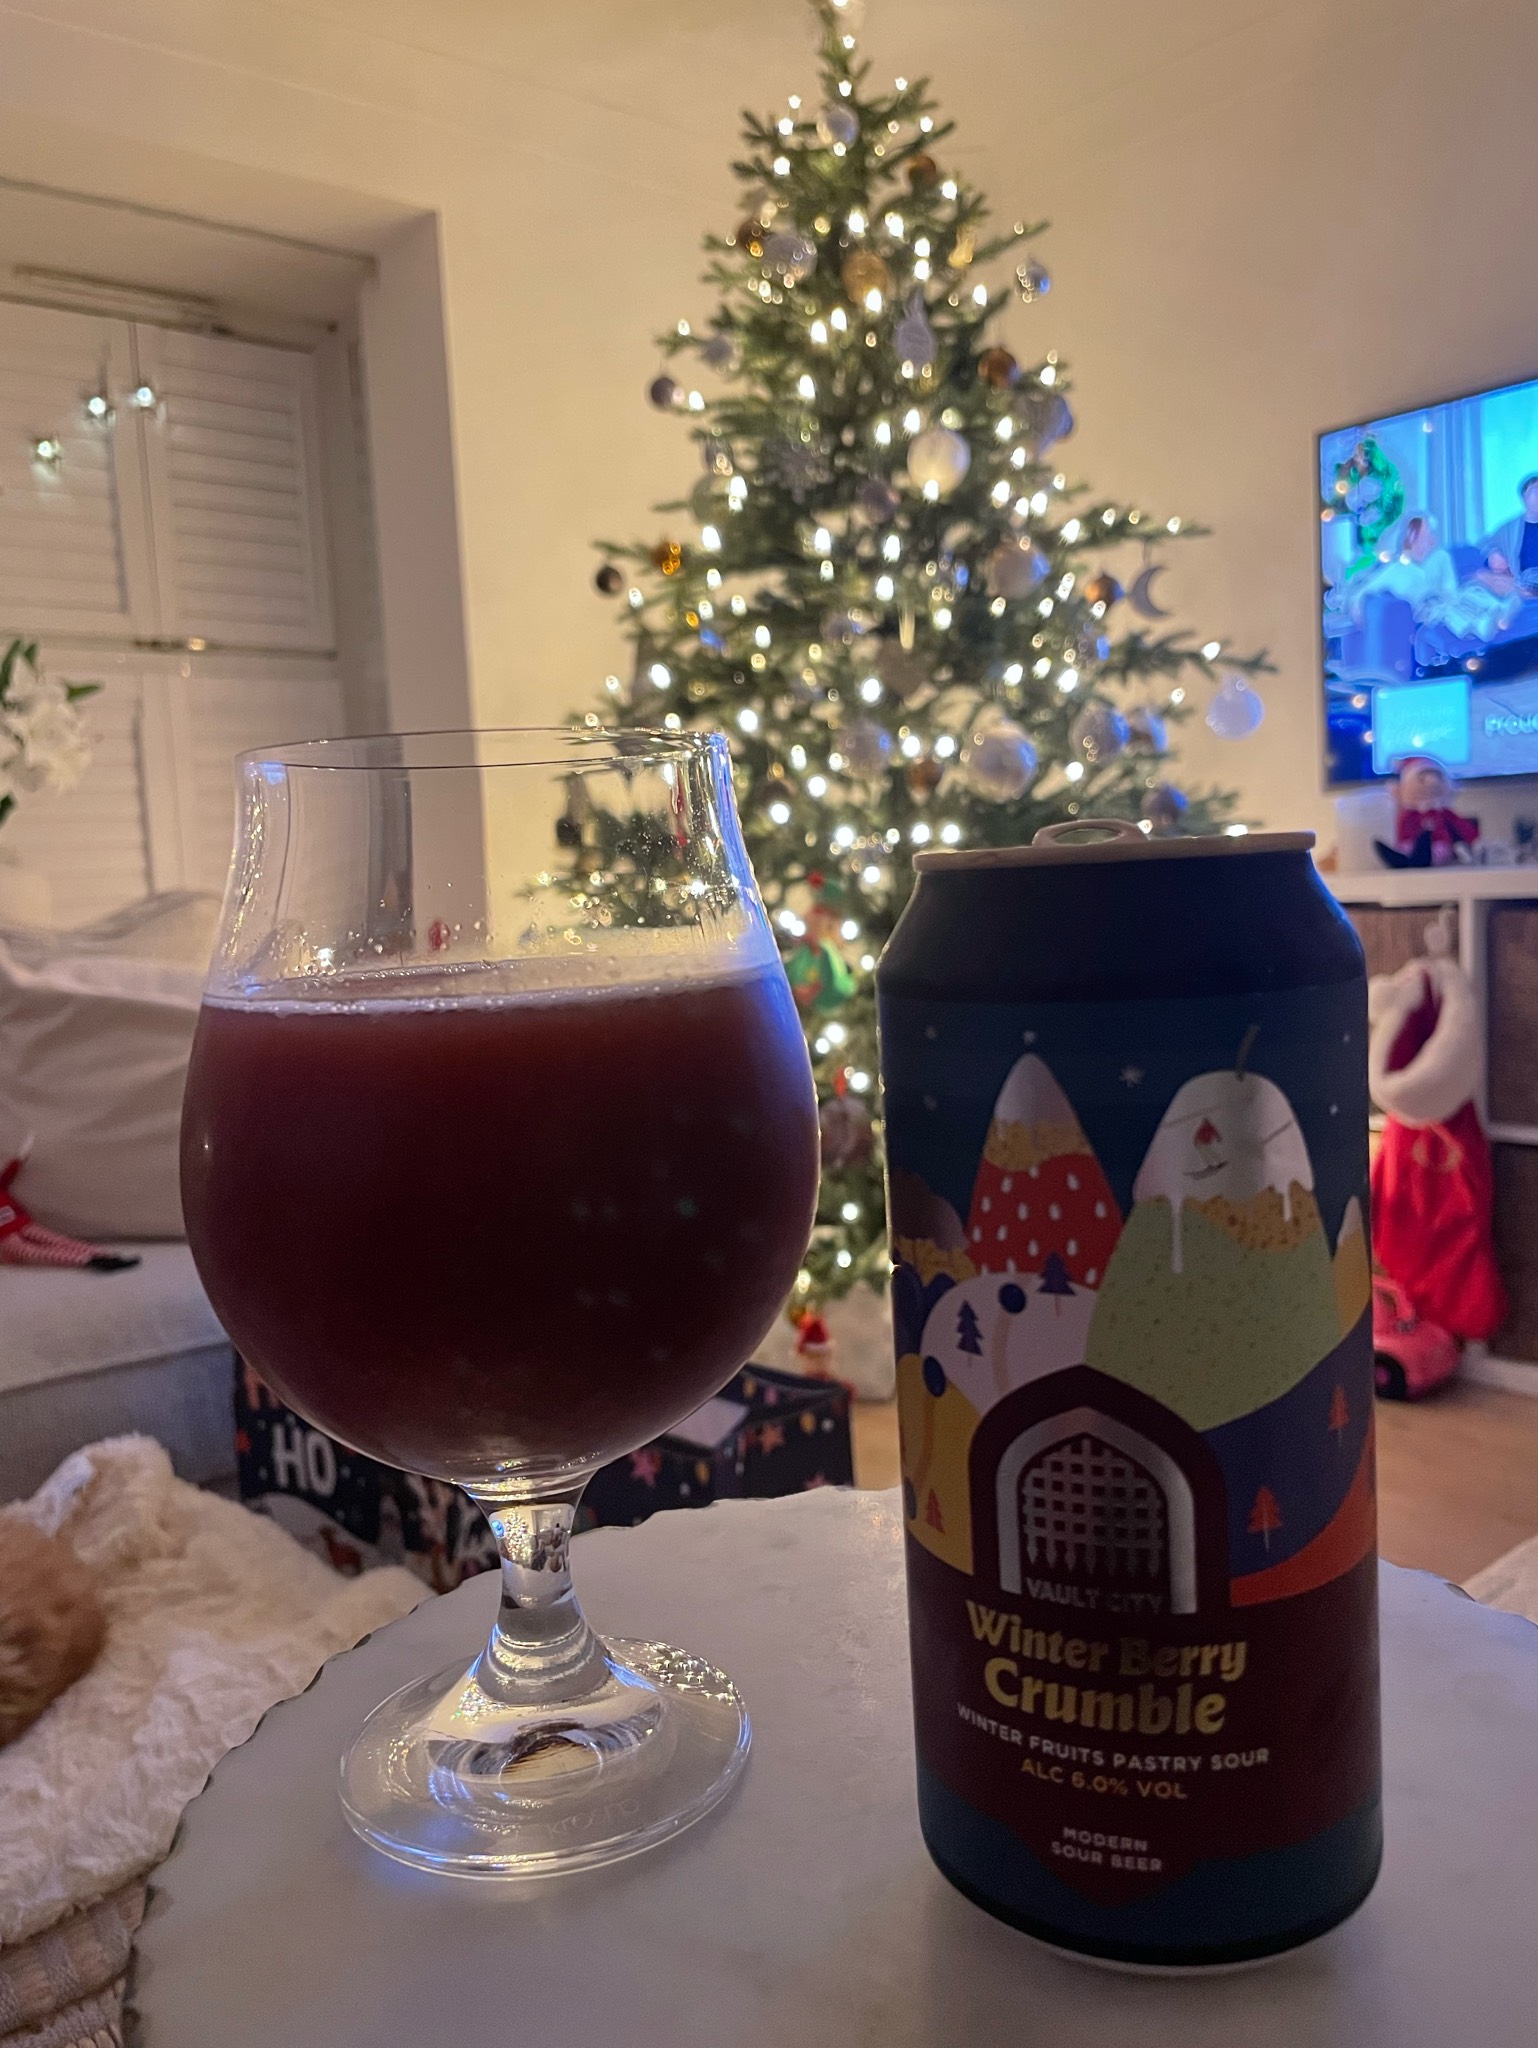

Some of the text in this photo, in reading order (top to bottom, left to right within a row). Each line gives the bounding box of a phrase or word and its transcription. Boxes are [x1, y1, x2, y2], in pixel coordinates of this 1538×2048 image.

[271, 1422, 338, 1498] HO
[1025, 1576, 1163, 1615] VAULT CITY
[965, 1599, 1248, 1682] Winter Berry
[983, 1656, 1228, 1735] Crumble
[957, 1702, 1270, 1773] WINTER FRUITS PASTRY SOUR
[1020, 1757, 1188, 1800] ALC 6.0% VOL
[1050, 1841, 1163, 1871] SOUR BEER
[1062, 1826, 1147, 1852] MODERN
